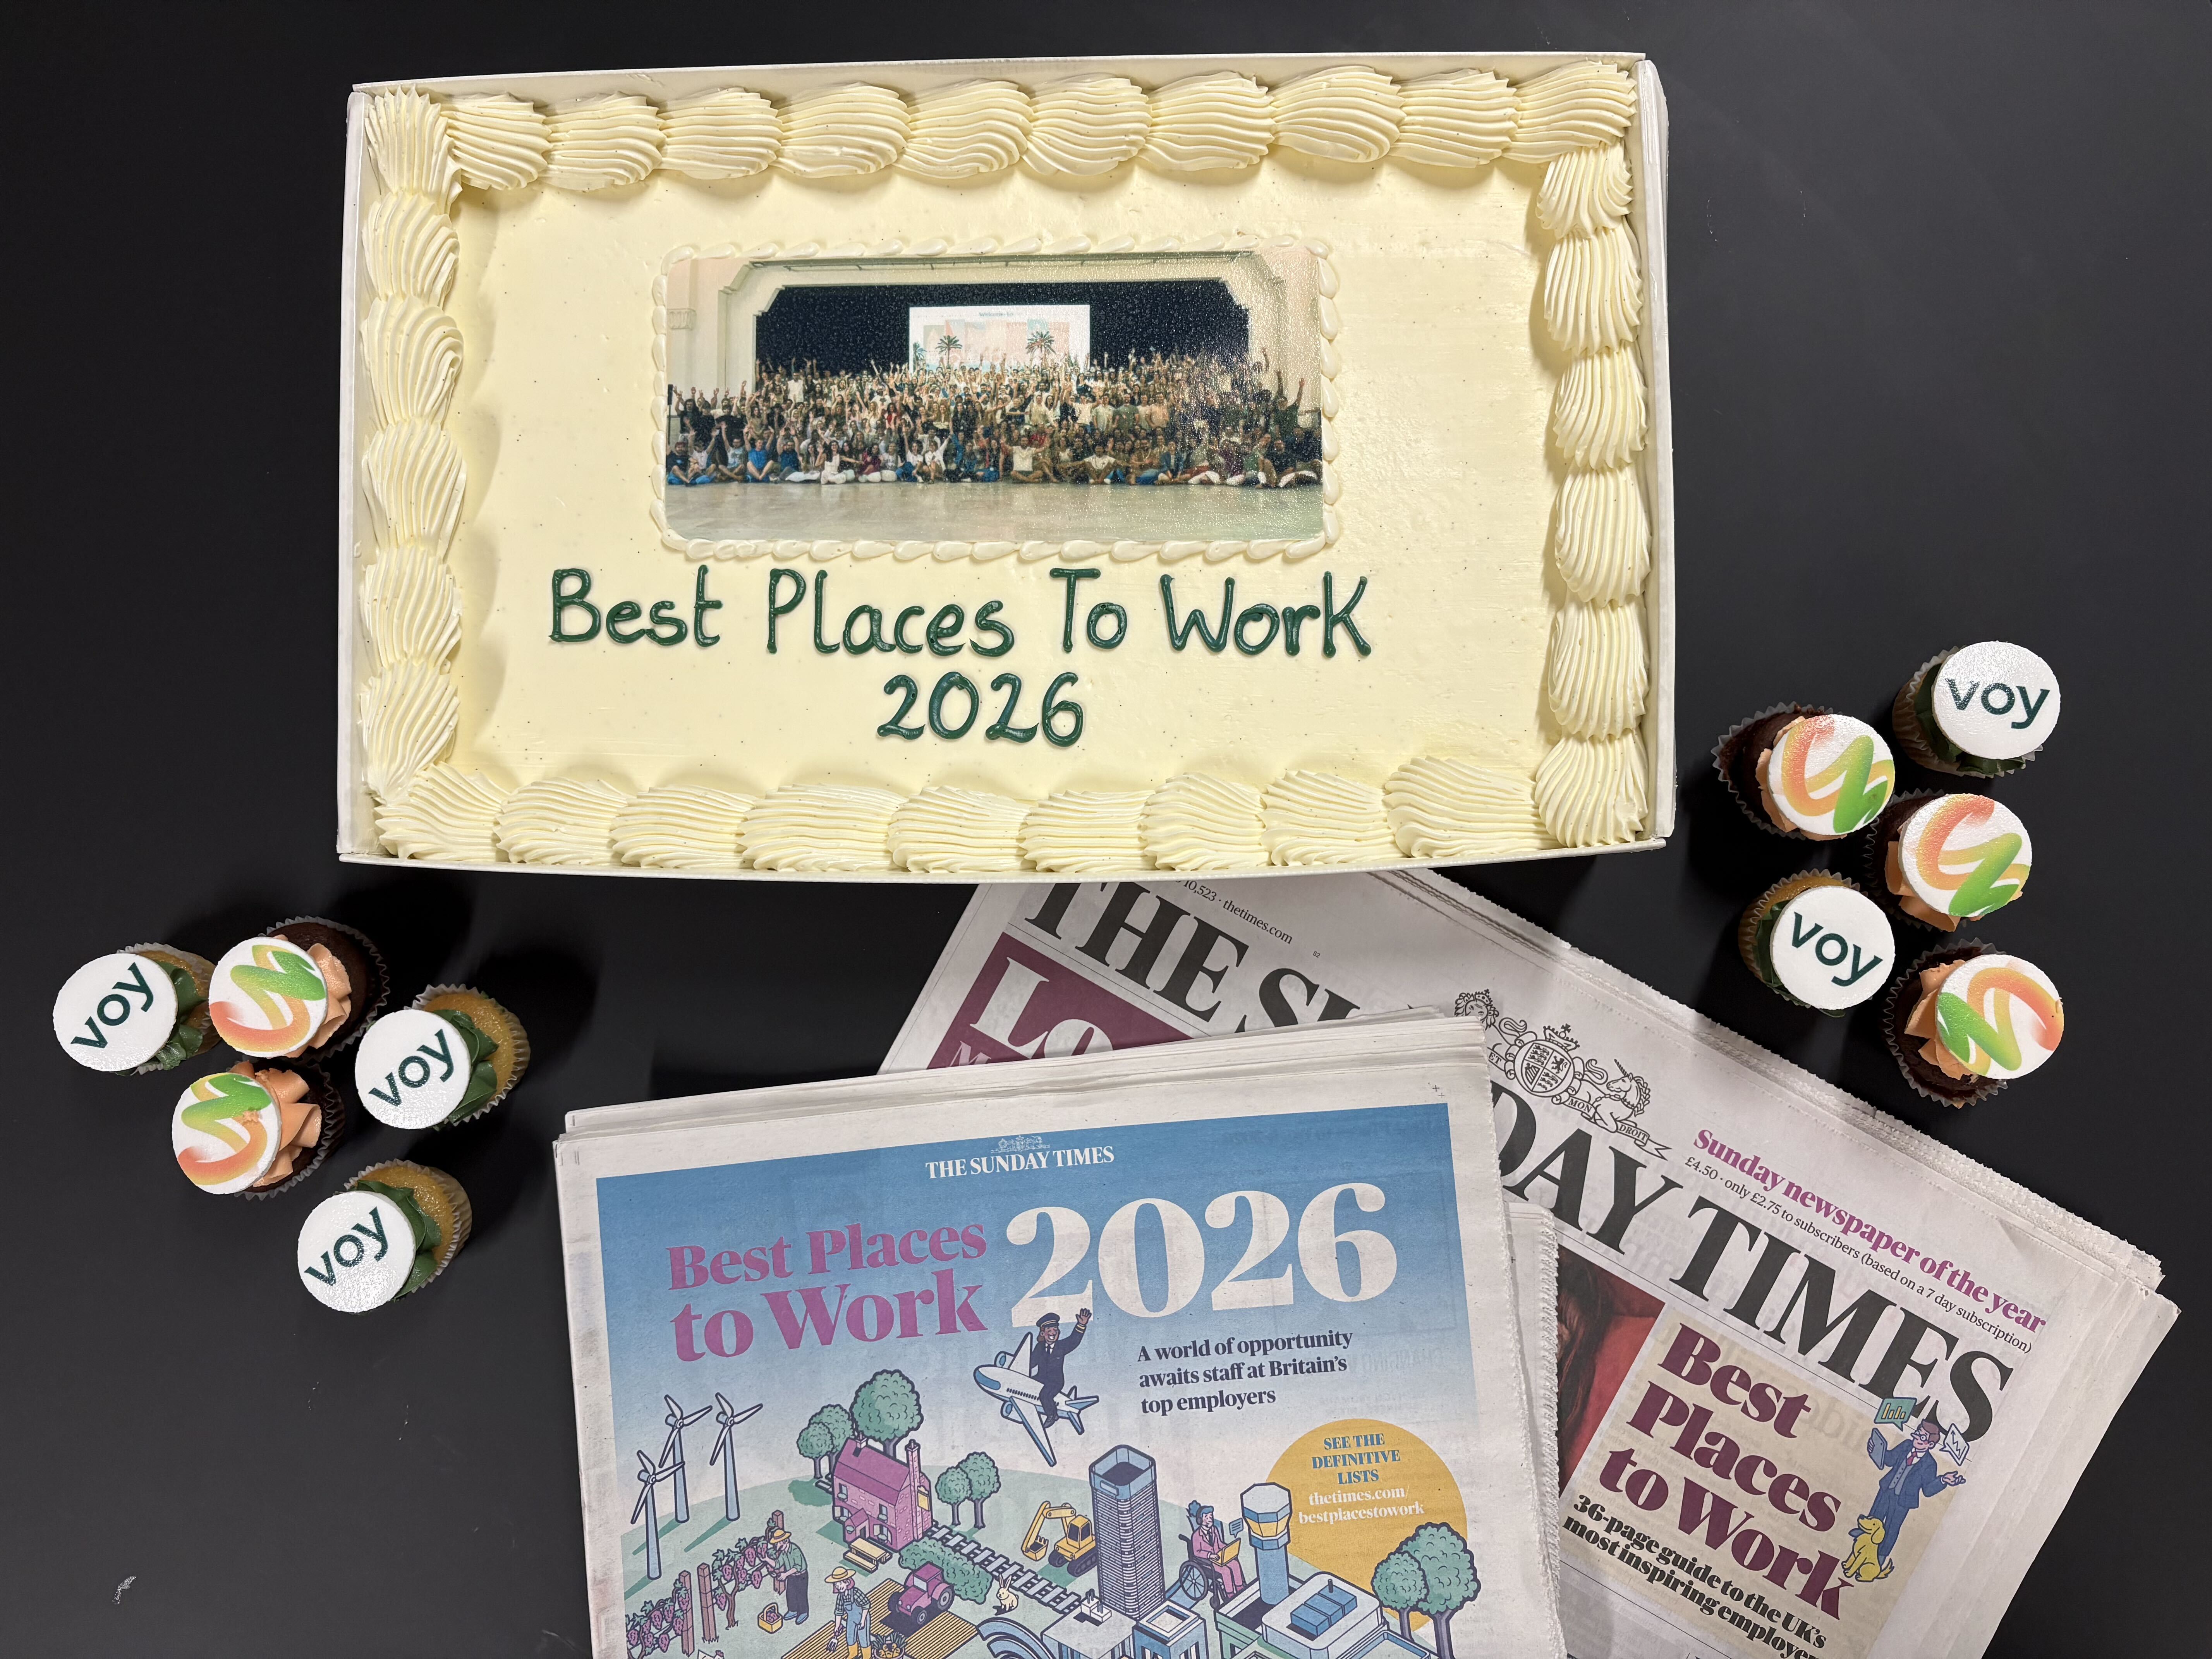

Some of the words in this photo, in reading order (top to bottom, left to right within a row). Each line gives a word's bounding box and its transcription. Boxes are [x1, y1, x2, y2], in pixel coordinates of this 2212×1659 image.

[548, 566, 723, 647] Best
[767, 568, 1017, 656] Places
[1049, 567, 1128, 653] To
[876, 671, 1085, 748] 2026
[1945, 678, 2051, 729] voy
[1183, 880, 1217, 902] 10,523
[1223, 899, 1293, 944] thetimes.com
[1791, 912, 1883, 987] voy
[1312, 950, 1321, 958] S2
[70, 962, 154, 1049] voy
[368, 1029, 454, 1107] voy
[1488, 1051, 1502, 1065] ET
[1568, 1098, 1592, 1112] MON
[1619, 1124, 1647, 1142] DROIT
[926, 1159, 967, 1178] THE
[970, 1151, 1049, 1175] SUNDAY
[1052, 1146, 1115, 1166] TIMES
[304, 1206, 389, 1286] voy
[666, 1236, 794, 1290] Best
[805, 1223, 988, 1274] Places
[1007, 1182, 1397, 1328] 2026
[1685, 1156, 1718, 1180] £4.50
[1724, 1179, 1751, 1199] only
[1750, 1193, 1782, 1214] £2.75
[1781, 1209, 1793, 1222] to
[1794, 1217, 1860, 1259] subscribers
[1861, 1253, 1901, 1281] (based
[1900, 1276, 1916, 1290] on
[1916, 1286, 1924, 1295] a
[1926, 1288, 1936, 1298] 7
[1934, 1294, 1957, 1313] day
[1956, 1307, 2032, 1354] subscription)
[1693, 1129, 1786, 1192] Sunday
[1782, 1180, 1920, 1264] newspaper
[1919, 1257, 1954, 1281] of
[1946, 1269, 1989, 1303] the
[1985, 1293, 2046, 1333] year
[670, 1304, 754, 1362] to
[760, 1268, 988, 1350] Work
[1137, 1346, 1152, 1362] A
[1154, 1340, 1211, 1360] world
[1214, 1337, 1235, 1355] of
[1237, 1330, 1353, 1356] opportunity
[1669, 1195, 2014, 1443] TIMES
[1139, 1368, 1200, 1387] awaits
[1203, 1362, 1245, 1382] staff
[1247, 1362, 1266, 1378] at
[1141, 1397, 1173, 1416] top
[1176, 1390, 1276, 1412] employers
[1657, 1322, 1812, 1439] Best
[1312, 1449, 1401, 1469] DEFINITIVE
[1323, 1436, 1351, 1450] SEE
[1353, 1433, 1385, 1447] THE
[1338, 1469, 1379, 1484] LISTS
[1626, 1381, 1842, 1533] Places
[1298, 1501, 1425, 1525] bestplacestowork
[1599, 1448, 1669, 1511] to
[1678, 1475, 1855, 1621] Work
[1562, 1516, 1620, 1556] most
[1616, 1543, 1721, 1616] inspiring
[1573, 1494, 1660, 1553] 36-page
[1655, 1547, 1721, 1589] guide
[1720, 1580, 1744, 1602] to
[1743, 1593, 1781, 1623] the
